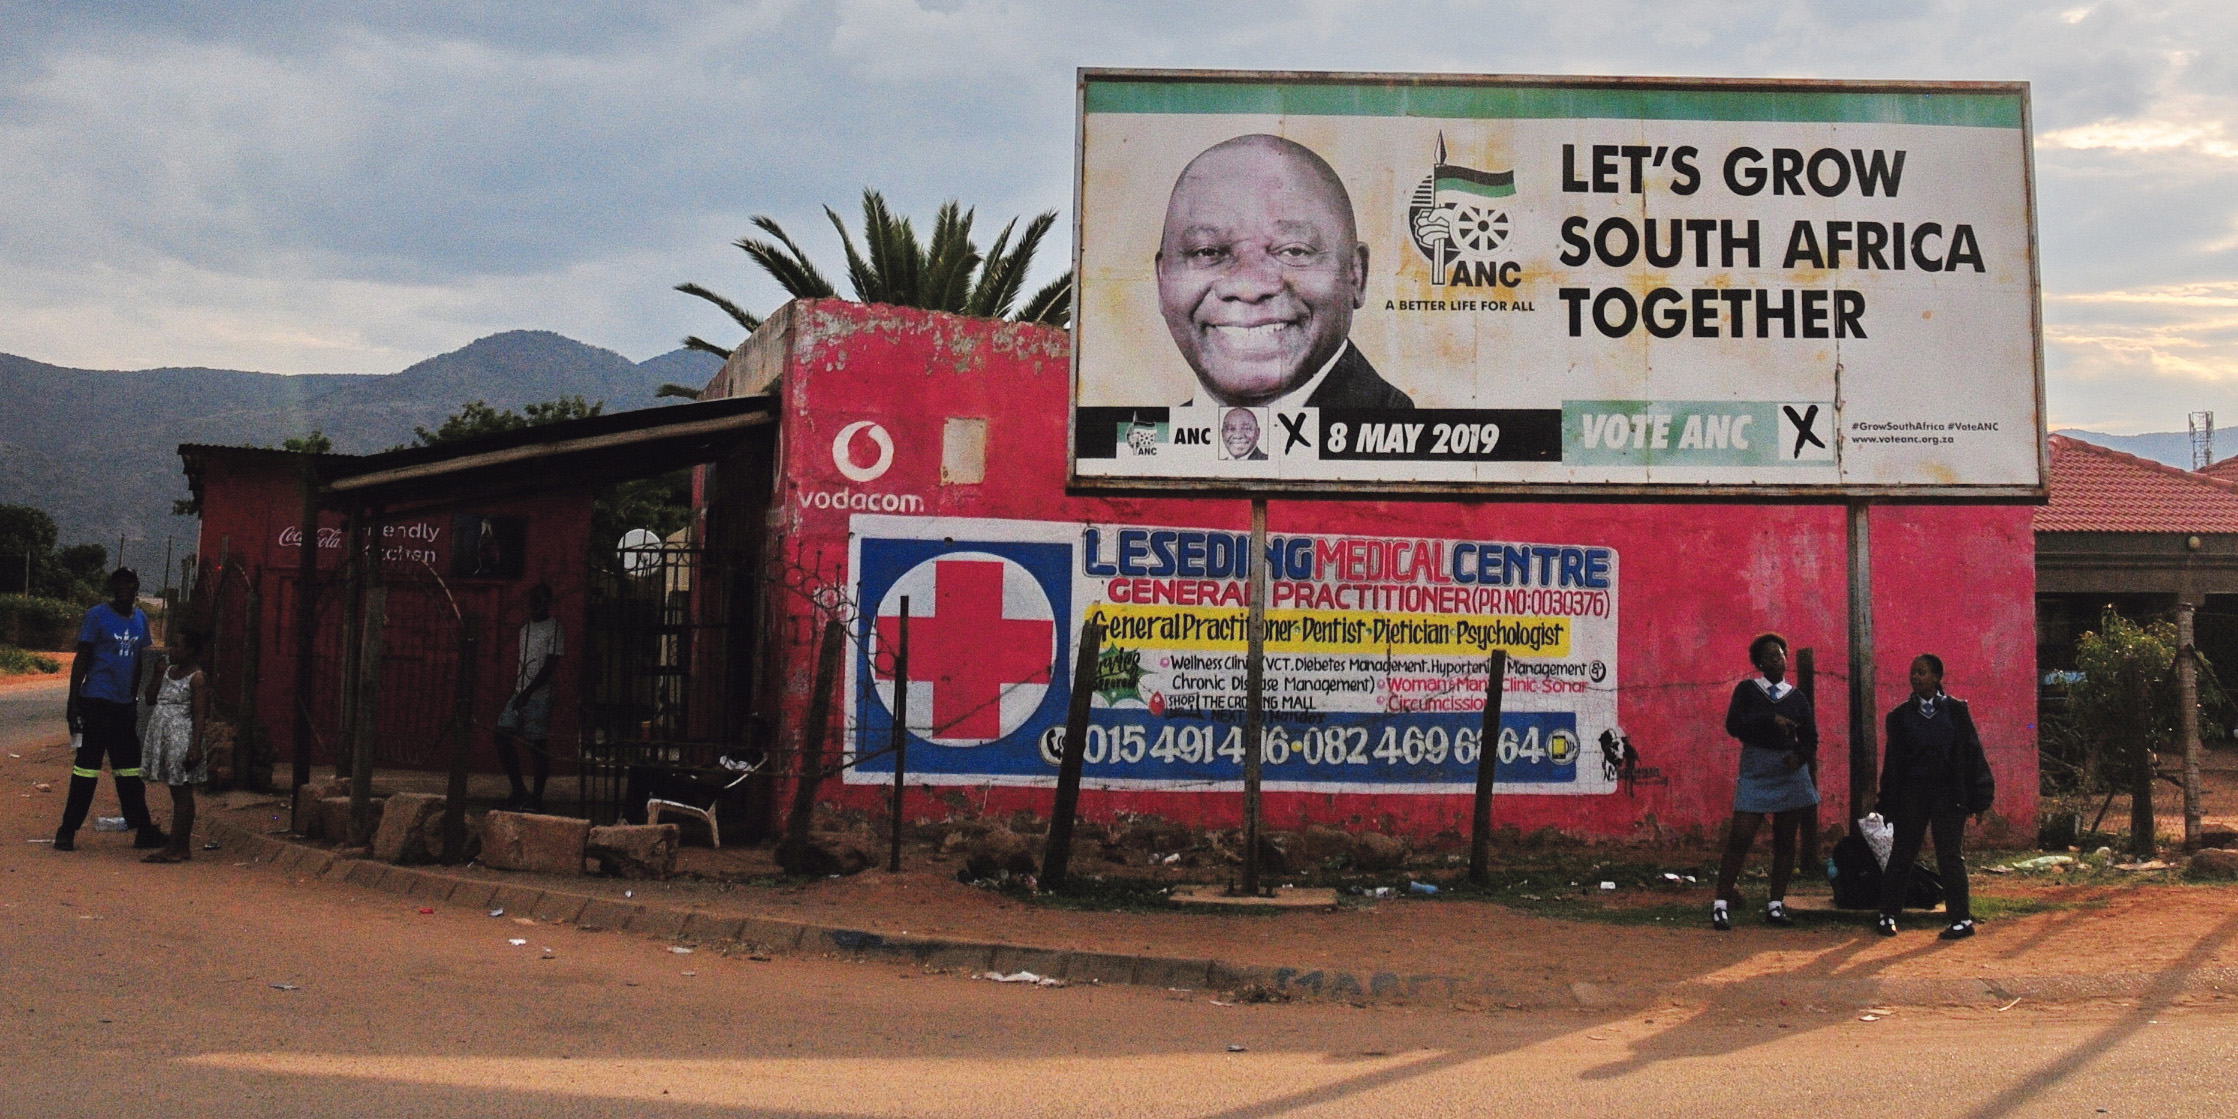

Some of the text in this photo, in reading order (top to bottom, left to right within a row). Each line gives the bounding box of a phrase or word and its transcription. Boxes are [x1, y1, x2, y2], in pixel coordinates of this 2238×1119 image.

[1561, 143, 1906, 198] LET'S GROW
[1559, 215, 1986, 273] SOUTH AFRICA
[1450, 260, 1522, 288] ANC
[1385, 300, 1536, 312] A BETTER LIFE FOR ALL
[1558, 286, 1868, 339] TOGETHER
[1174, 427, 1211, 445] ANC
[1327, 422, 1500, 454] 8 MAY 2019
[1581, 413, 1754, 451] VOTE ANC
[1851, 422, 2000, 432] #GrowSouthAfrica #VoteANC
[1138, 447, 1157, 456] ANC
[1851, 436, 1955, 446] www.voteanc.org.za
[797, 486, 925, 512] vodacom
[279, 525, 342, 548] Cocaola
[1083, 528, 1313, 581] LESEDING
[1452, 543, 1611, 588] CENTRE
[1182, 612, 1299, 642] Practitoner
[1302, 616, 1366, 644] Dentist
[1373, 618, 1449, 644] Dietician
[1456, 619, 1564, 651] Psychologist
[1170, 654, 1223, 670] Wellness
[1507, 660, 1587, 679] Management
[1172, 672, 1375, 695] Chronic Disase Management)
[1168, 695, 1317, 710] SHOP THE CRONG MALL
[1083, 723, 1146, 764] 015
[1303, 725, 1369, 766] 082
[1372, 725, 1450, 766] 469
